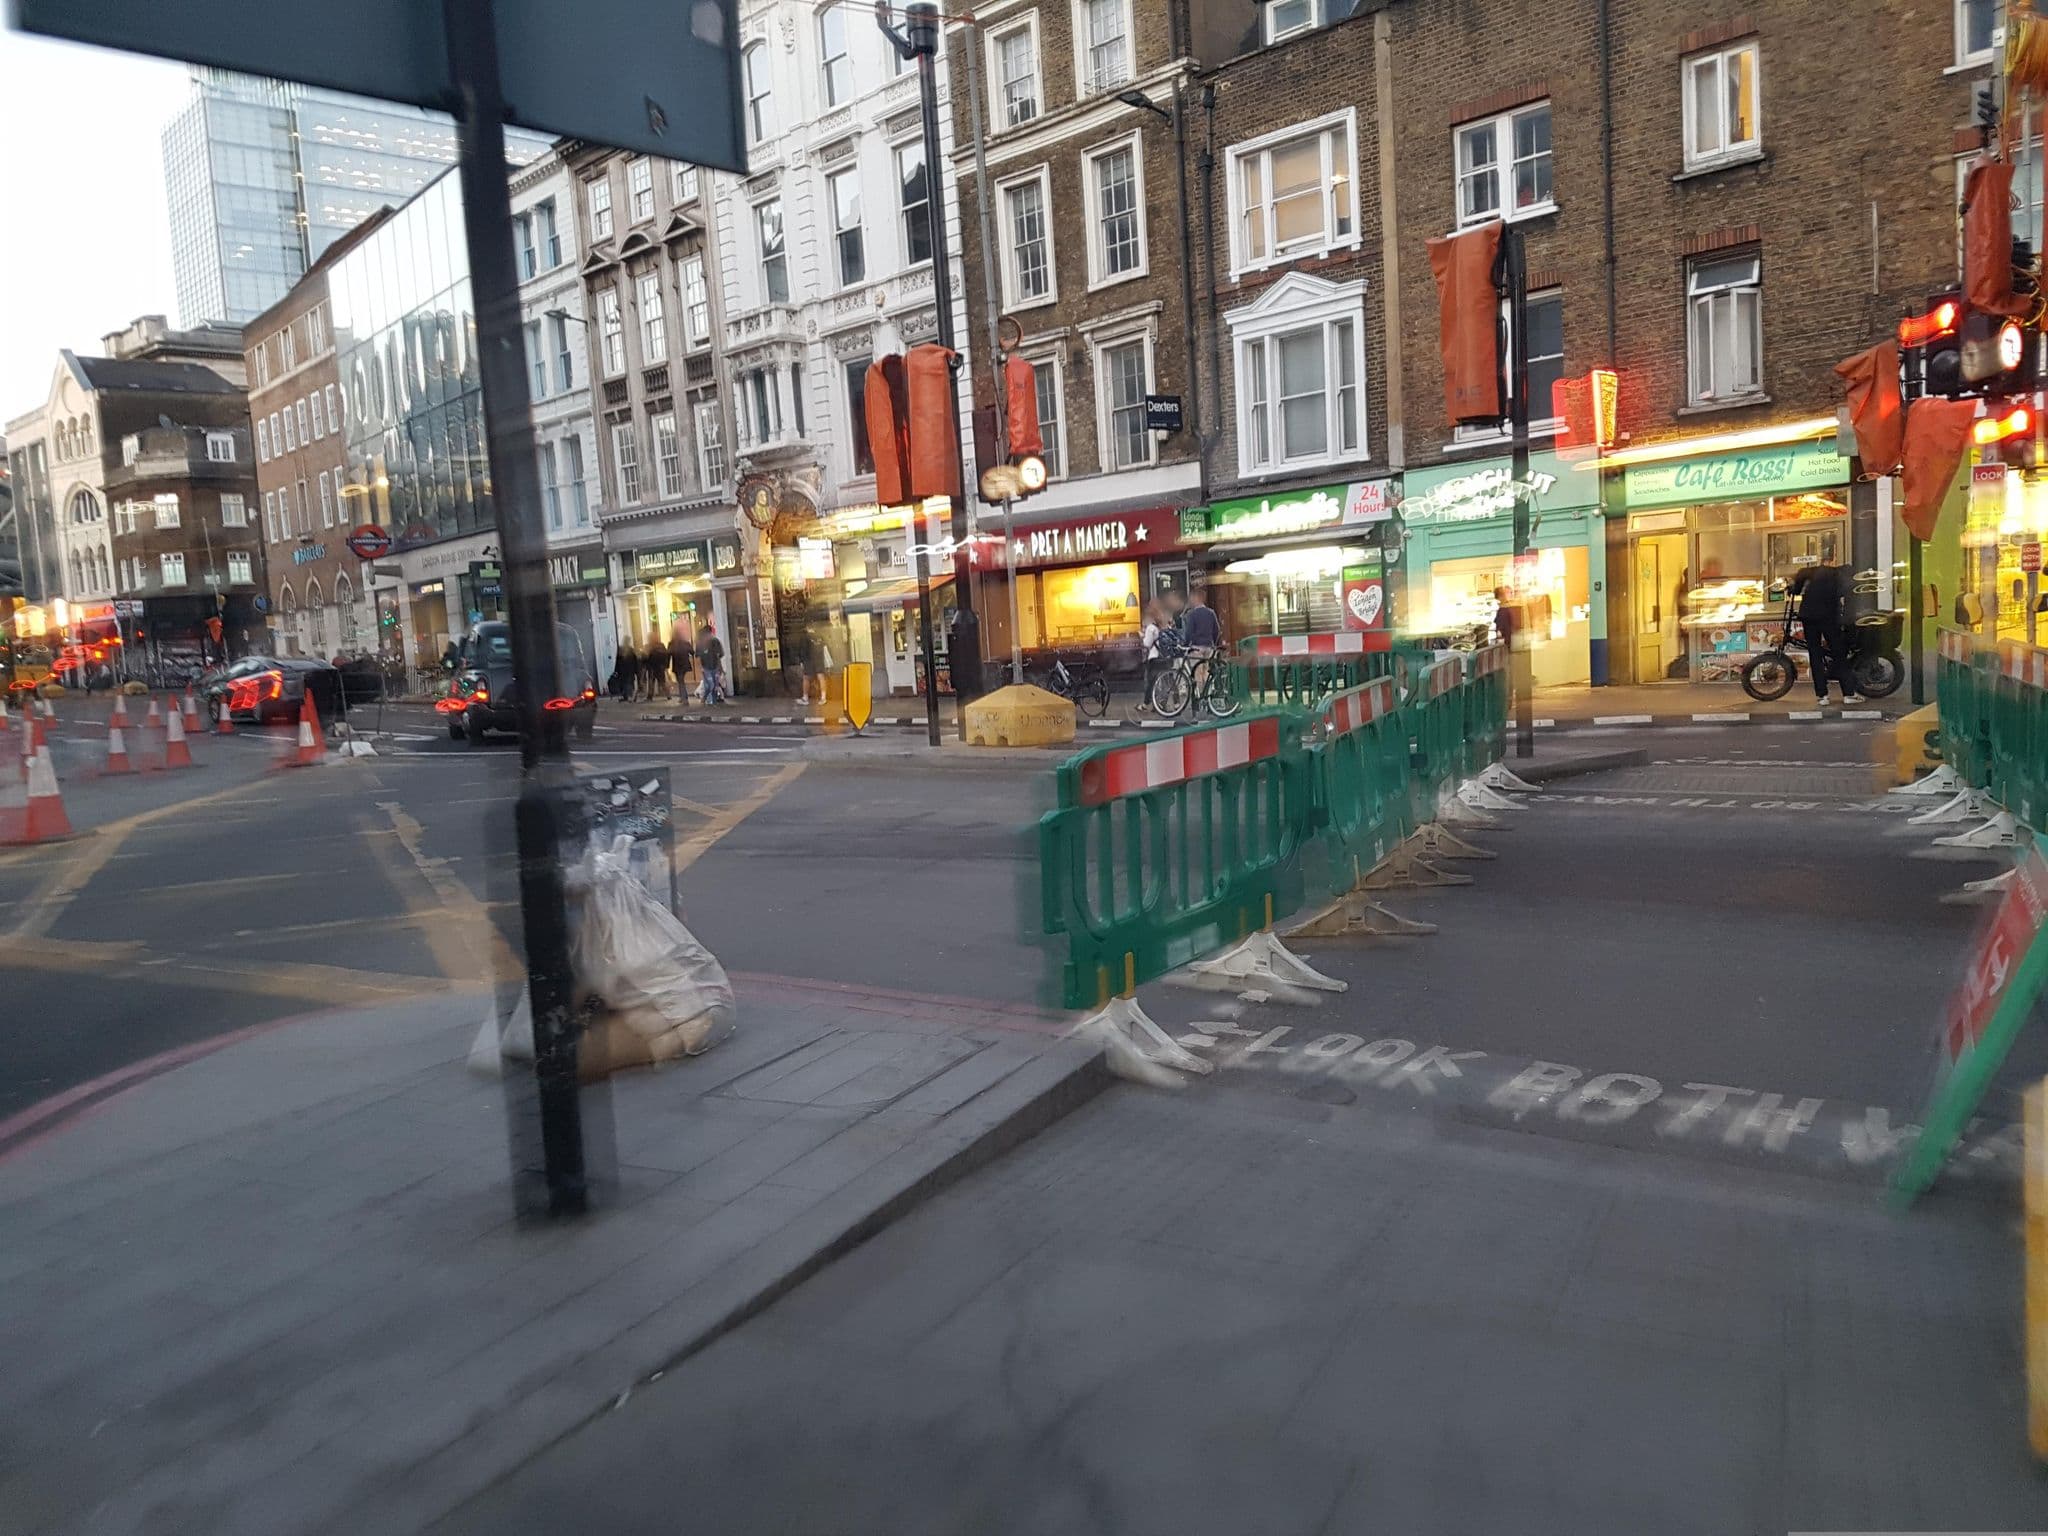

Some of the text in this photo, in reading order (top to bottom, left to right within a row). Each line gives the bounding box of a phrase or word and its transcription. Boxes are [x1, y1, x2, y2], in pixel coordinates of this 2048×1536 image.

[1148, 400, 1179, 412] Dexters
[1808, 456, 1840, 466] Hot Food
[1674, 451, 1795, 490] Café Rossi
[1800, 467, 1841, 477] Cold Drinks
[1975, 472, 2003, 480] LOOK
[1360, 486, 1379, 501] 24
[1353, 501, 1386, 514] Hours
[1031, 521, 1128, 557] PRET A MANGER
[550, 555, 580, 585] RMACY
[1836, 802, 1942, 814] OOK
[1245, 1025, 1488, 1078] LOOK
[1500, 1058, 1825, 1151] BOTH
